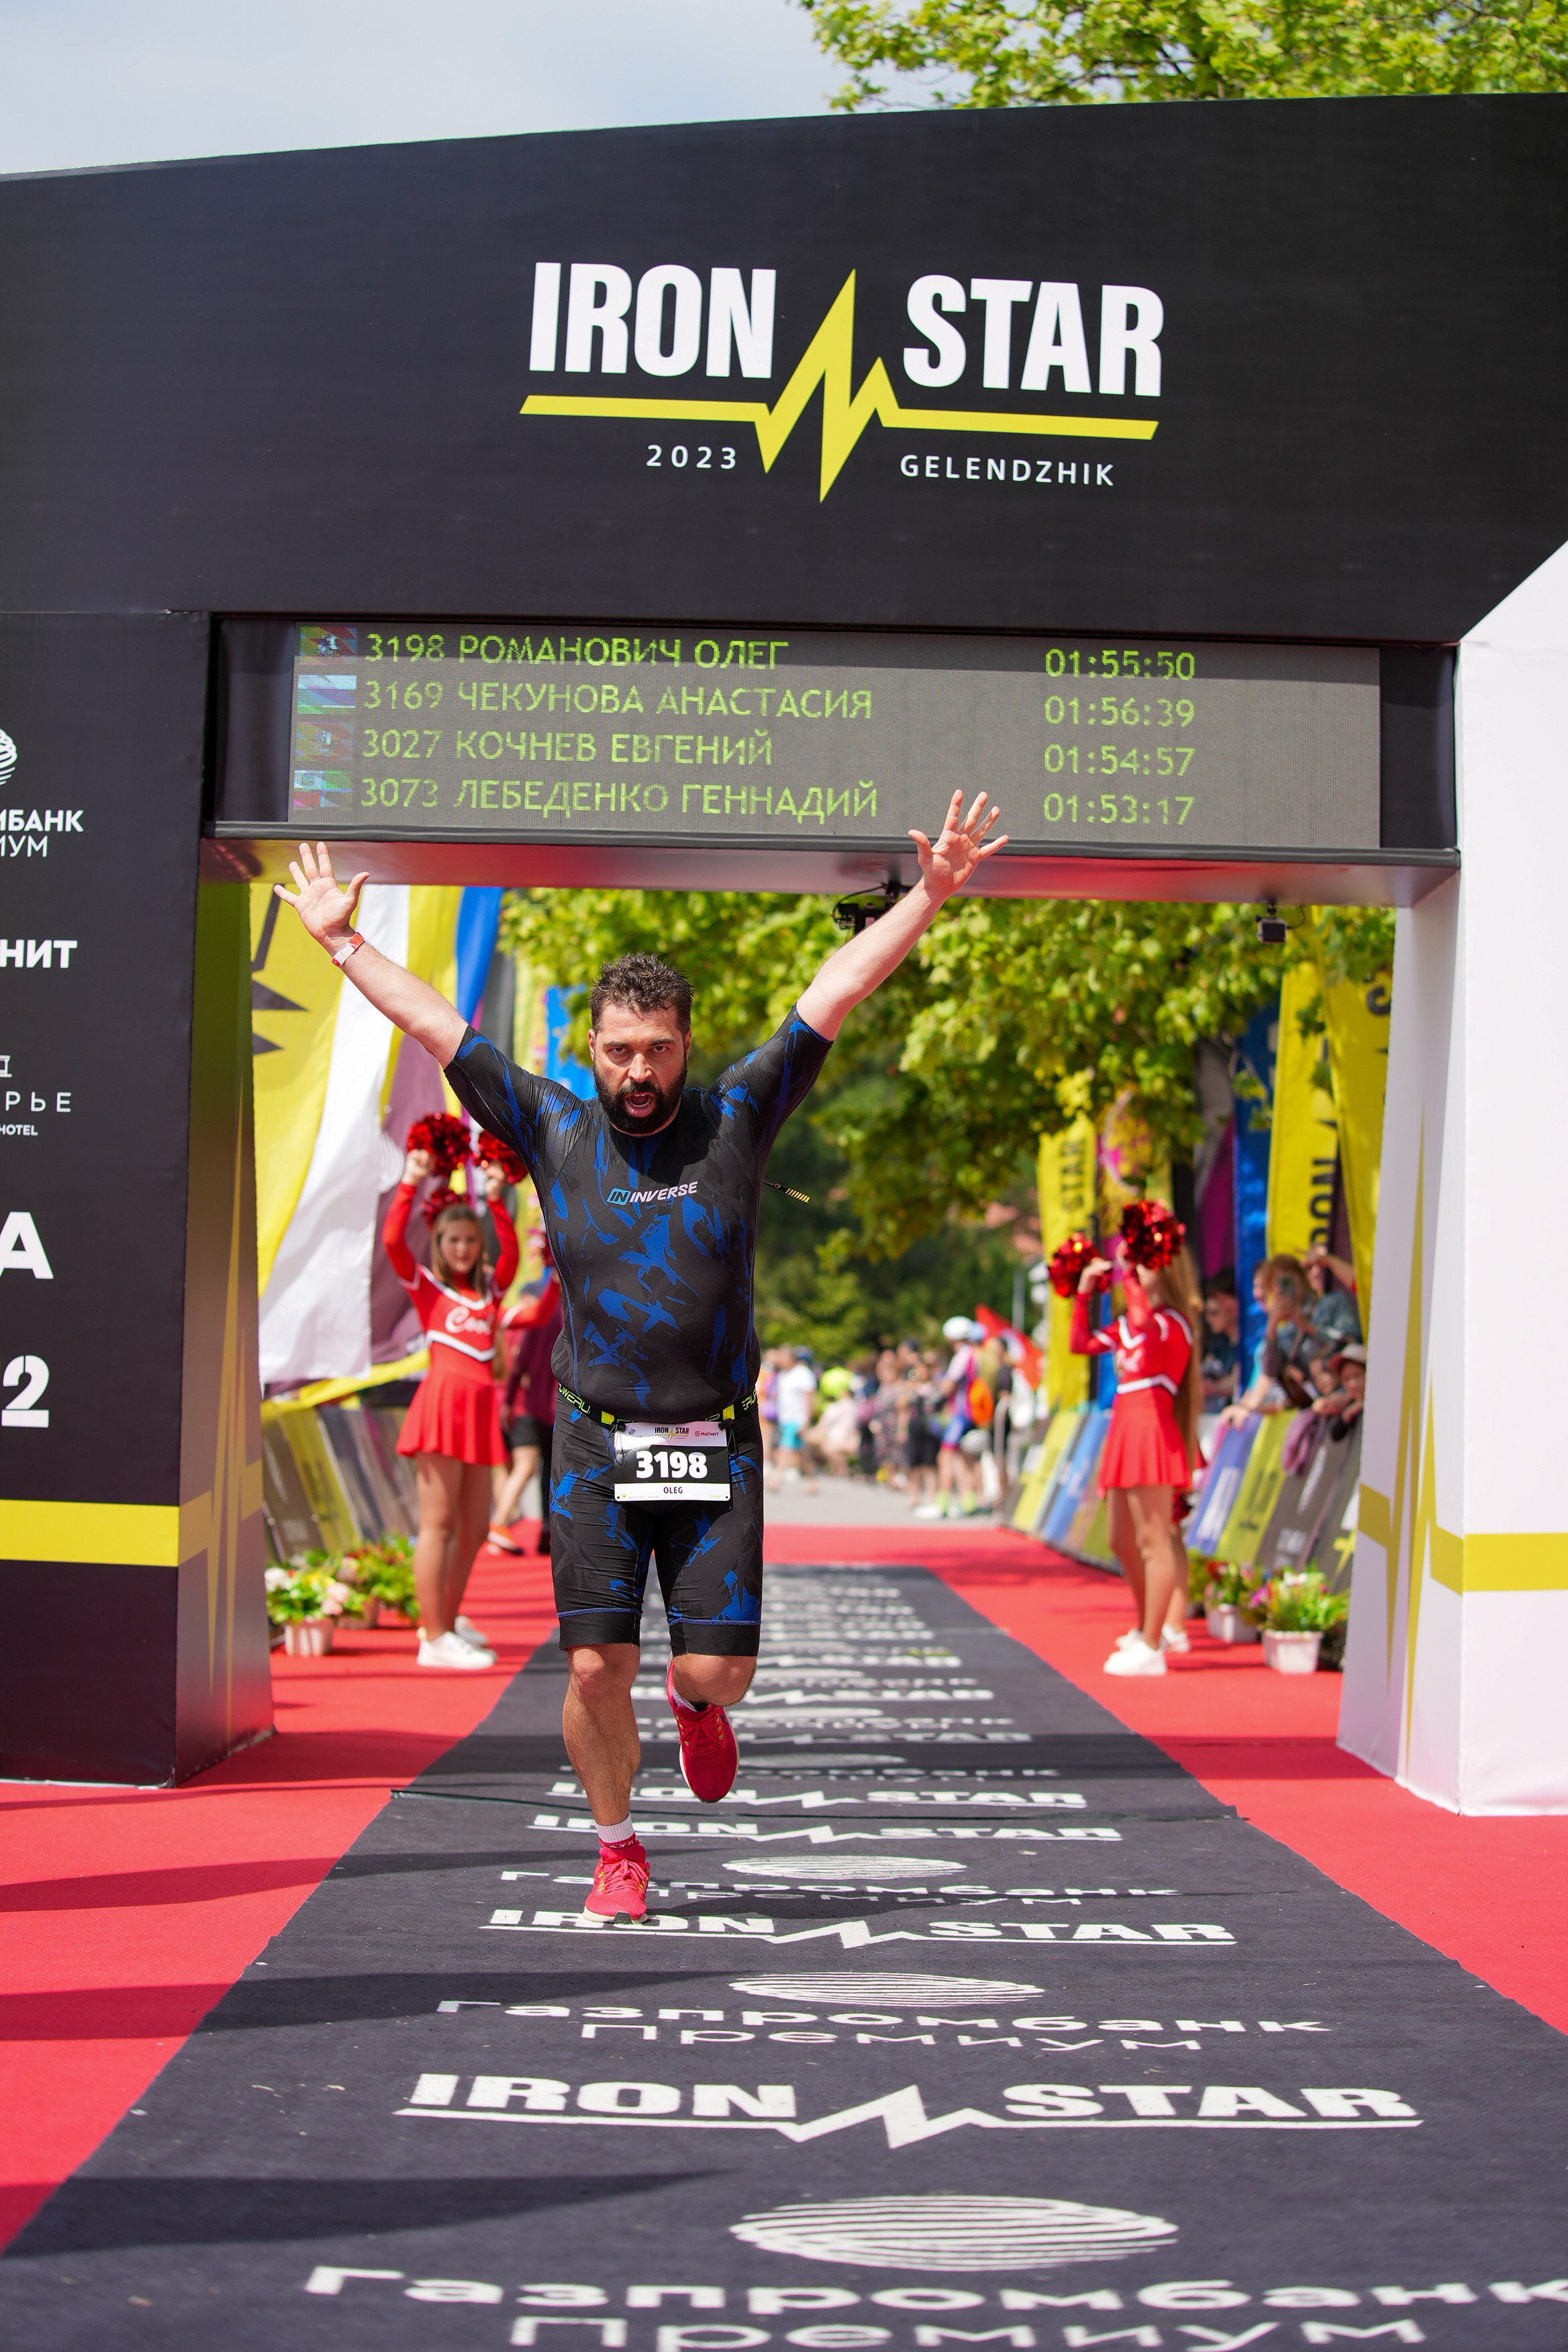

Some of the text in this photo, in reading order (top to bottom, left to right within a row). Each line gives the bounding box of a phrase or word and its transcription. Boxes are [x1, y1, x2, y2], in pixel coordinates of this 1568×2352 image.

[529, 262, 1164, 397] IRON STAR
[646, 444, 736, 469] 2023
[900, 454, 1114, 486] GELENDZHIK
[365, 634, 1195, 681] 3198 РОМАНОВИЧ ОЛЕГ 01:55:50
[364, 680, 1195, 728] 3169 ЧЕКУНОВА АНАСТАСИЯ 01:56:39
[363, 729, 1195, 776] 3027 КОЧНЕВ ЕВГЕНИЙ 01:54:57
[362, 778, 1195, 825] 3073 ЛЕБЕДЕНКО ГЕННАДИЙ 01:53:17
[630, 1181, 699, 1204] INVERSE
[1, 1355, 50, 1428] 2
[654, 1426, 690, 1435] IRON STAR
[636, 1450, 707, 1479] 3198
[663, 1486, 683, 1495] OLEG
[550, 1781, 1087, 1804] ION STAR
[879, 1827, 1122, 1838] STAR
[490, 1909, 1234, 1939] IRON STAR
[436, 2000, 1333, 2031] Газпромбанк
[581, 2023, 1202, 2051] Премиум
[409, 2073, 1418, 2118] IRON STAR
[304, 2265, 1568, 2315] Газпромбанк
[509, 2316, 1428, 2352] Премиум
